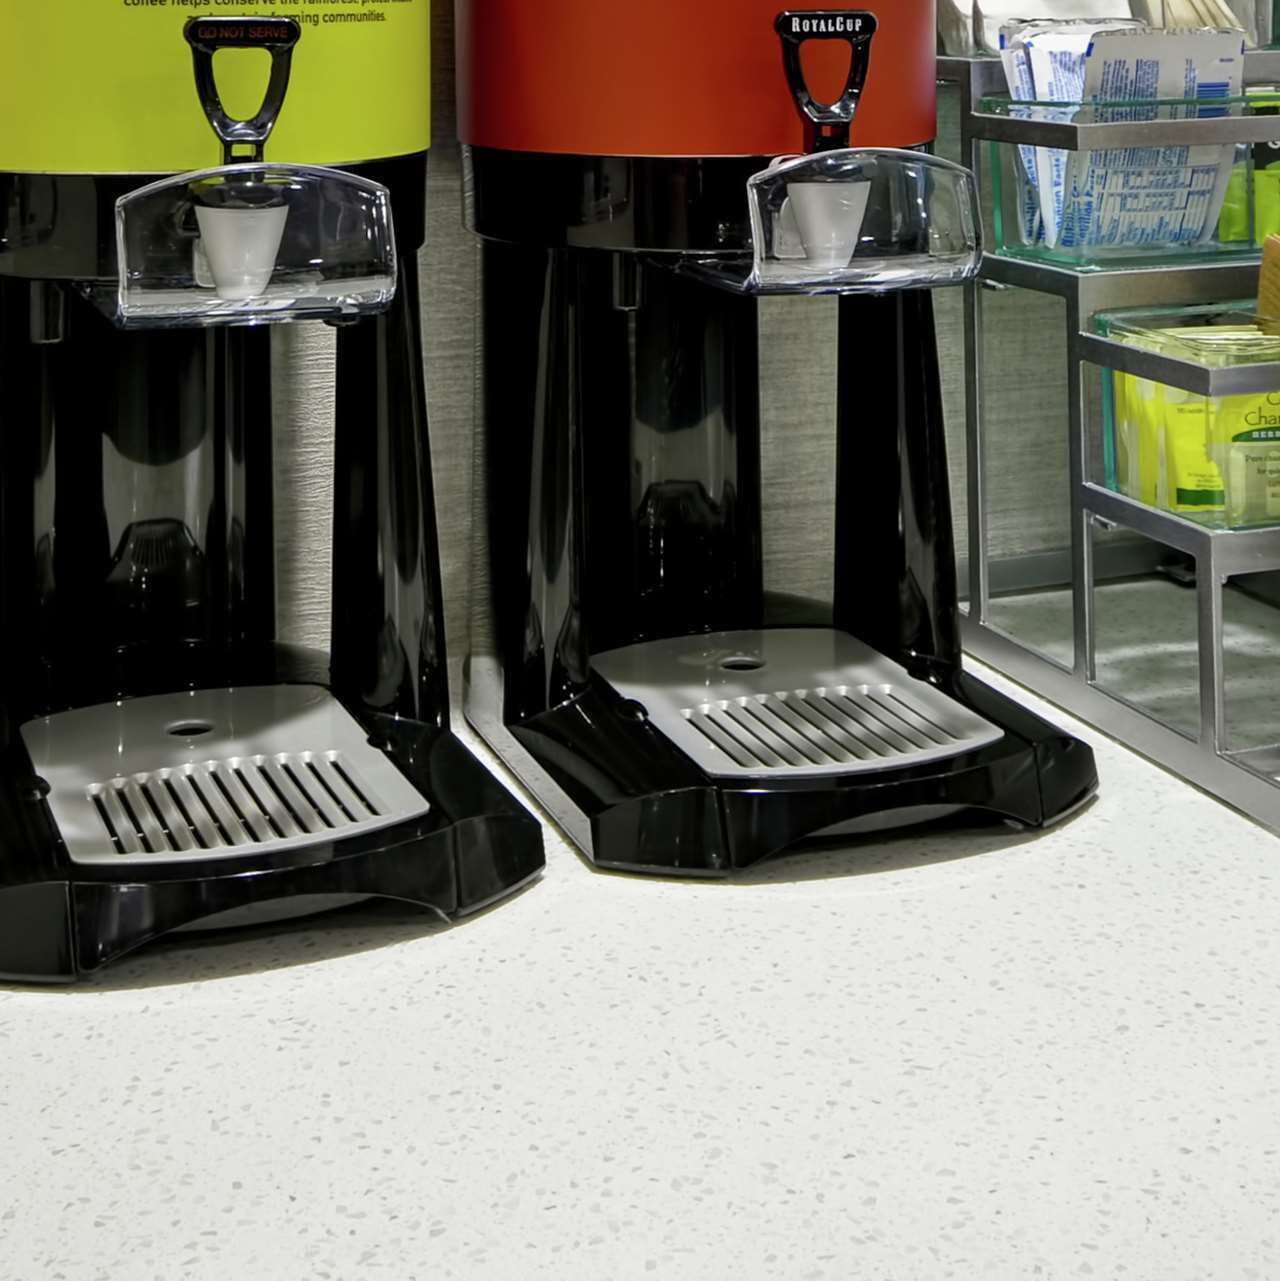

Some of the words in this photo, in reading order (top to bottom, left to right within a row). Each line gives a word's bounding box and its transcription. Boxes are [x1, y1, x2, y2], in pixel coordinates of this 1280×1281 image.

[322, 10, 386, 23] communities.
[219, 26, 244, 38] NOT
[249, 25, 288, 38] SERVE
